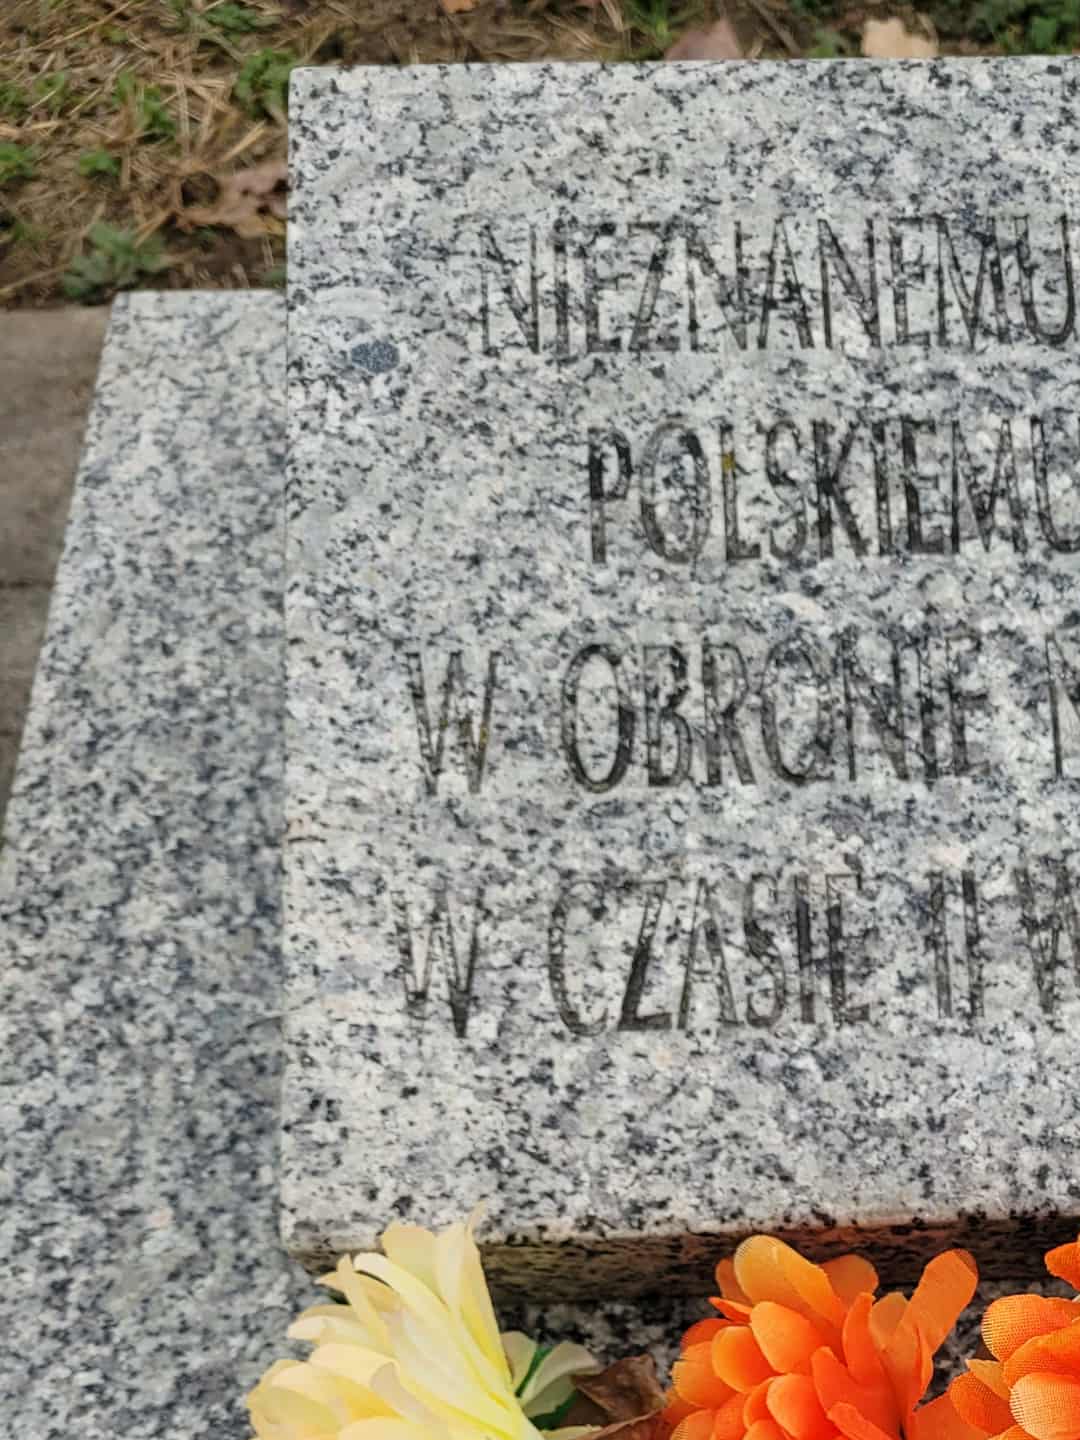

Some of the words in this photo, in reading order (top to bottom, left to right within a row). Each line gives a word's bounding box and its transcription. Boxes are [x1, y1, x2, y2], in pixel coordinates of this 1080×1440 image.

[480, 212, 1076, 354] NIEZNANEMU
[404, 650, 498, 796] W
[560, 632, 994, 794] OBRONIE
[394, 890, 484, 1038] W
[550, 870, 872, 1036] CZASIE
[928, 868, 984, 1020] II
